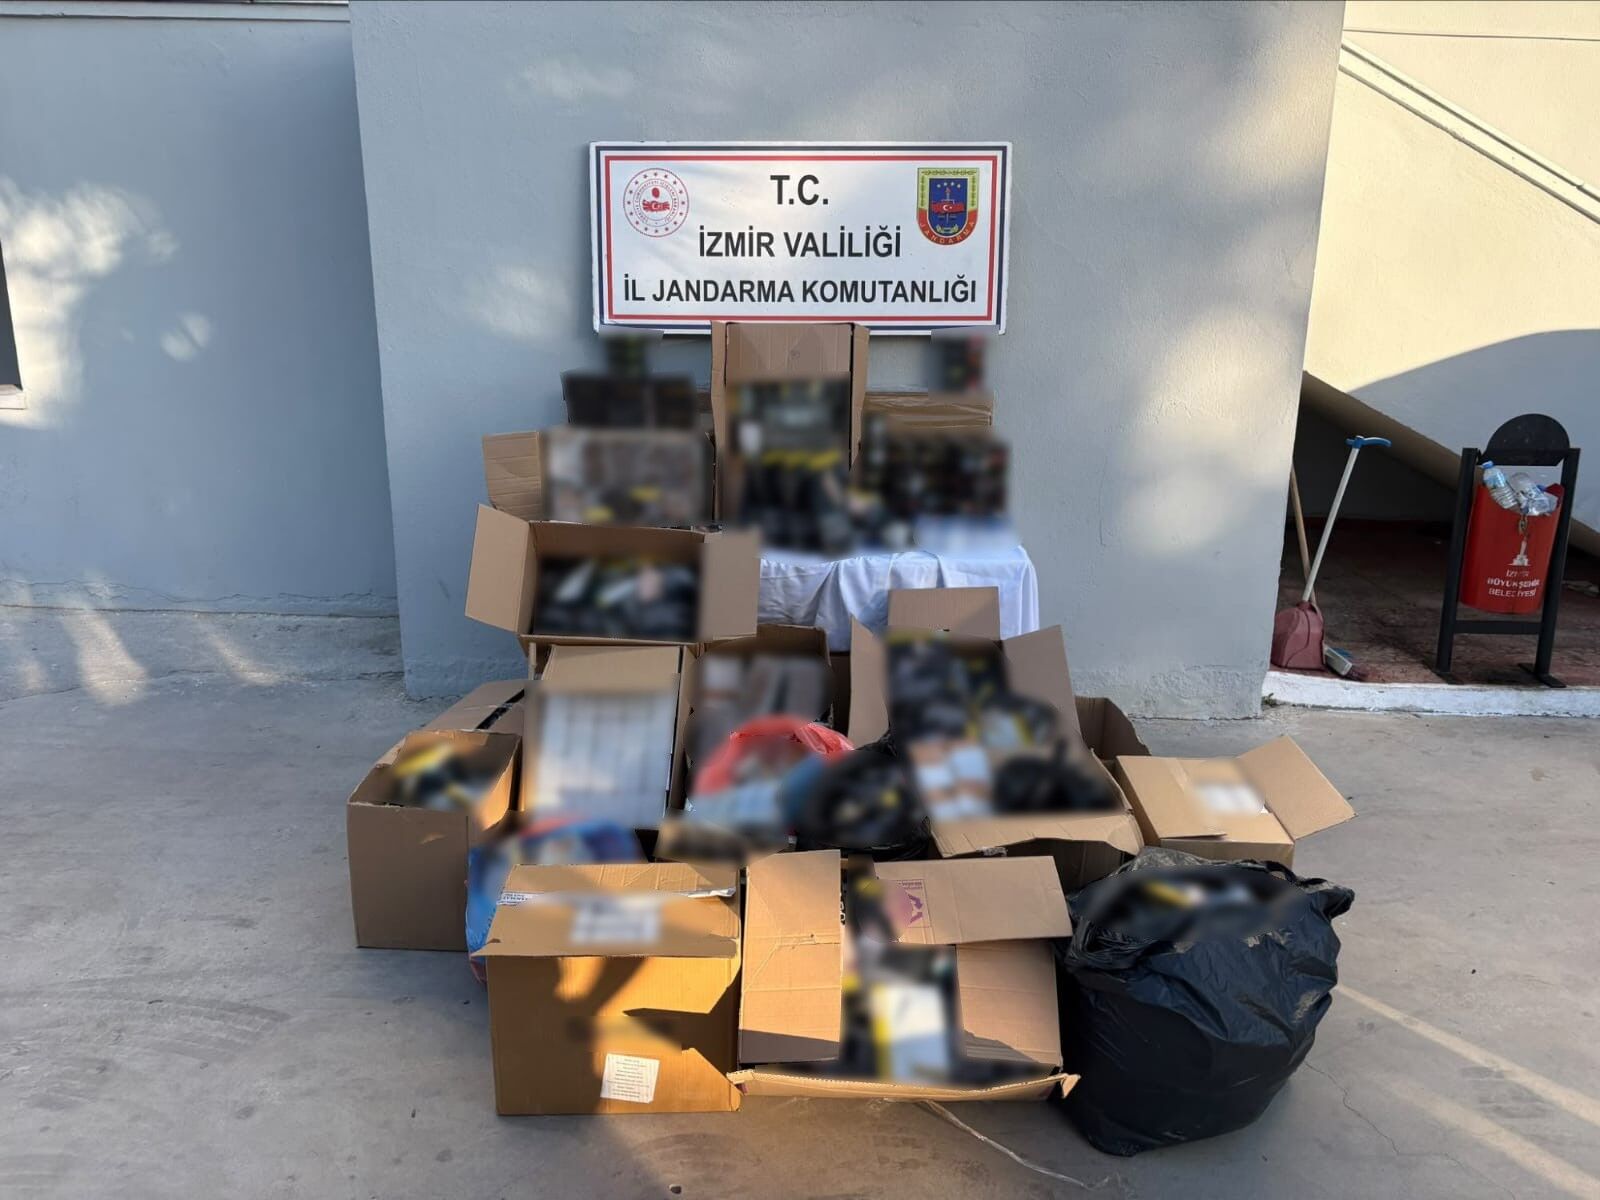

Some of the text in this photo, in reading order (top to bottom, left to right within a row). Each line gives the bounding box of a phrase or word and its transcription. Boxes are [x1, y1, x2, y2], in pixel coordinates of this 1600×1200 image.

[770, 174, 829, 205] T.C.
[699, 225, 901, 258] İZMİR VALİLİĞİ
[624, 273, 977, 303] İL JANDARMA KOMUTANLIĞI
